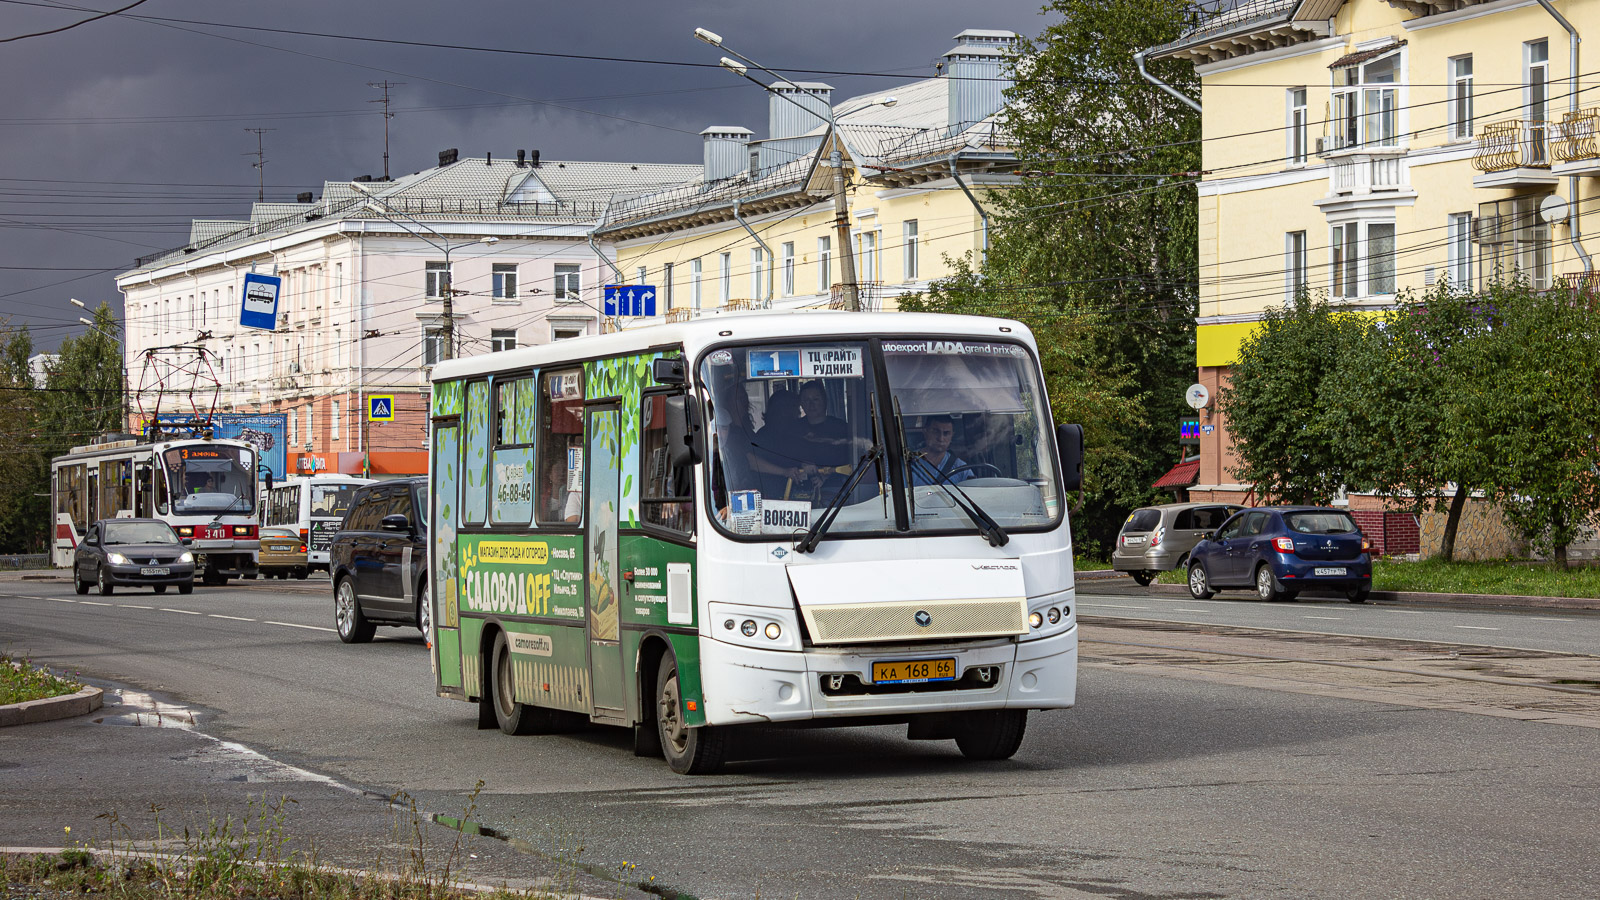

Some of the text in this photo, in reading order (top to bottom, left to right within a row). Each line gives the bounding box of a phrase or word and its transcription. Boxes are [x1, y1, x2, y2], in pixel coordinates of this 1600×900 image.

[881, 343, 927, 353] utoexport
[926, 341, 966, 354] LADA
[965, 343, 991, 354] grand
[992, 345, 1010, 356] prix
[769, 351, 780, 371] 1
[808, 349, 857, 364] ТЦ «РАЙТ»
[813, 363, 853, 376] РУДНИК
[181, 449, 189, 459] 3
[497, 482, 531, 503] 46-88-46
[737, 493, 749, 511] 1
[764, 509, 808, 528] ВОКЗАЛ
[205, 529, 226, 539] 340
[480, 546, 547, 561] МАГАЗИН ДЛЯ САДА И ОГОРОДА
[553, 569, 560, 581] ТЦ
[514, 637, 550, 652] camorezoff.ru
[880, 661, 950, 679] КА 168 66
